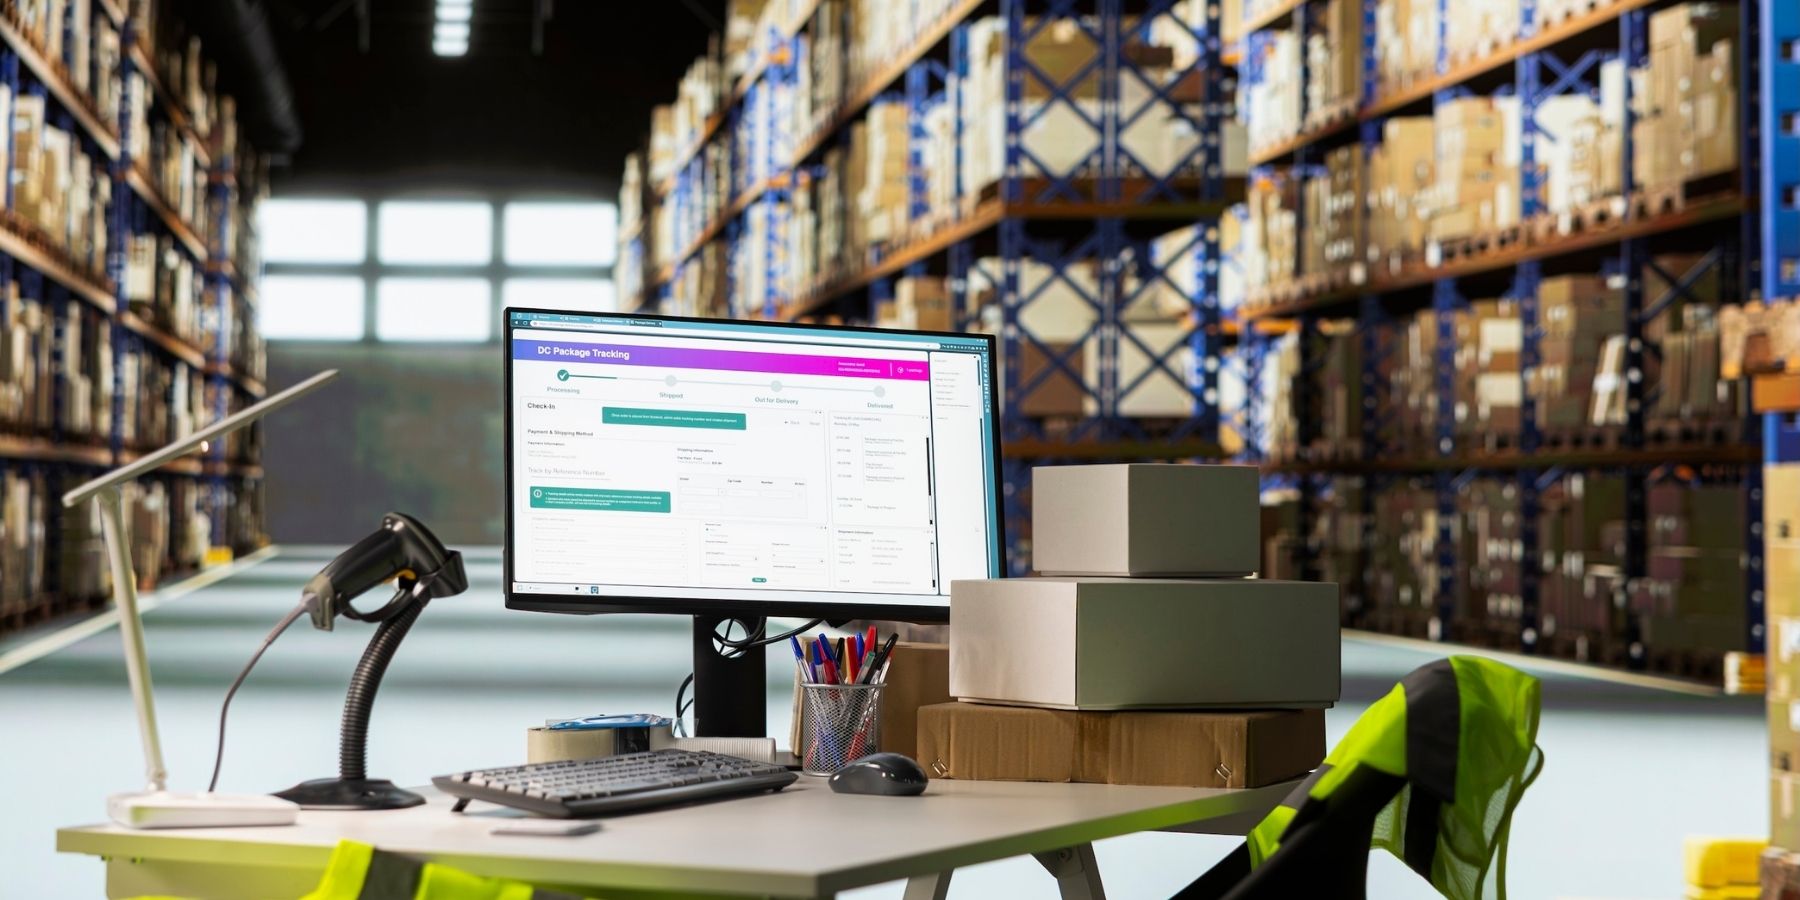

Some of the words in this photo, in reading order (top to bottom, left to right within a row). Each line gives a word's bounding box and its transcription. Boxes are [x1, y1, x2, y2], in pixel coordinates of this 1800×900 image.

[537, 346, 551, 354] DC
[553, 346, 590, 358] Package
[592, 349, 630, 360] Tracking
[547, 386, 580, 394] Processing
